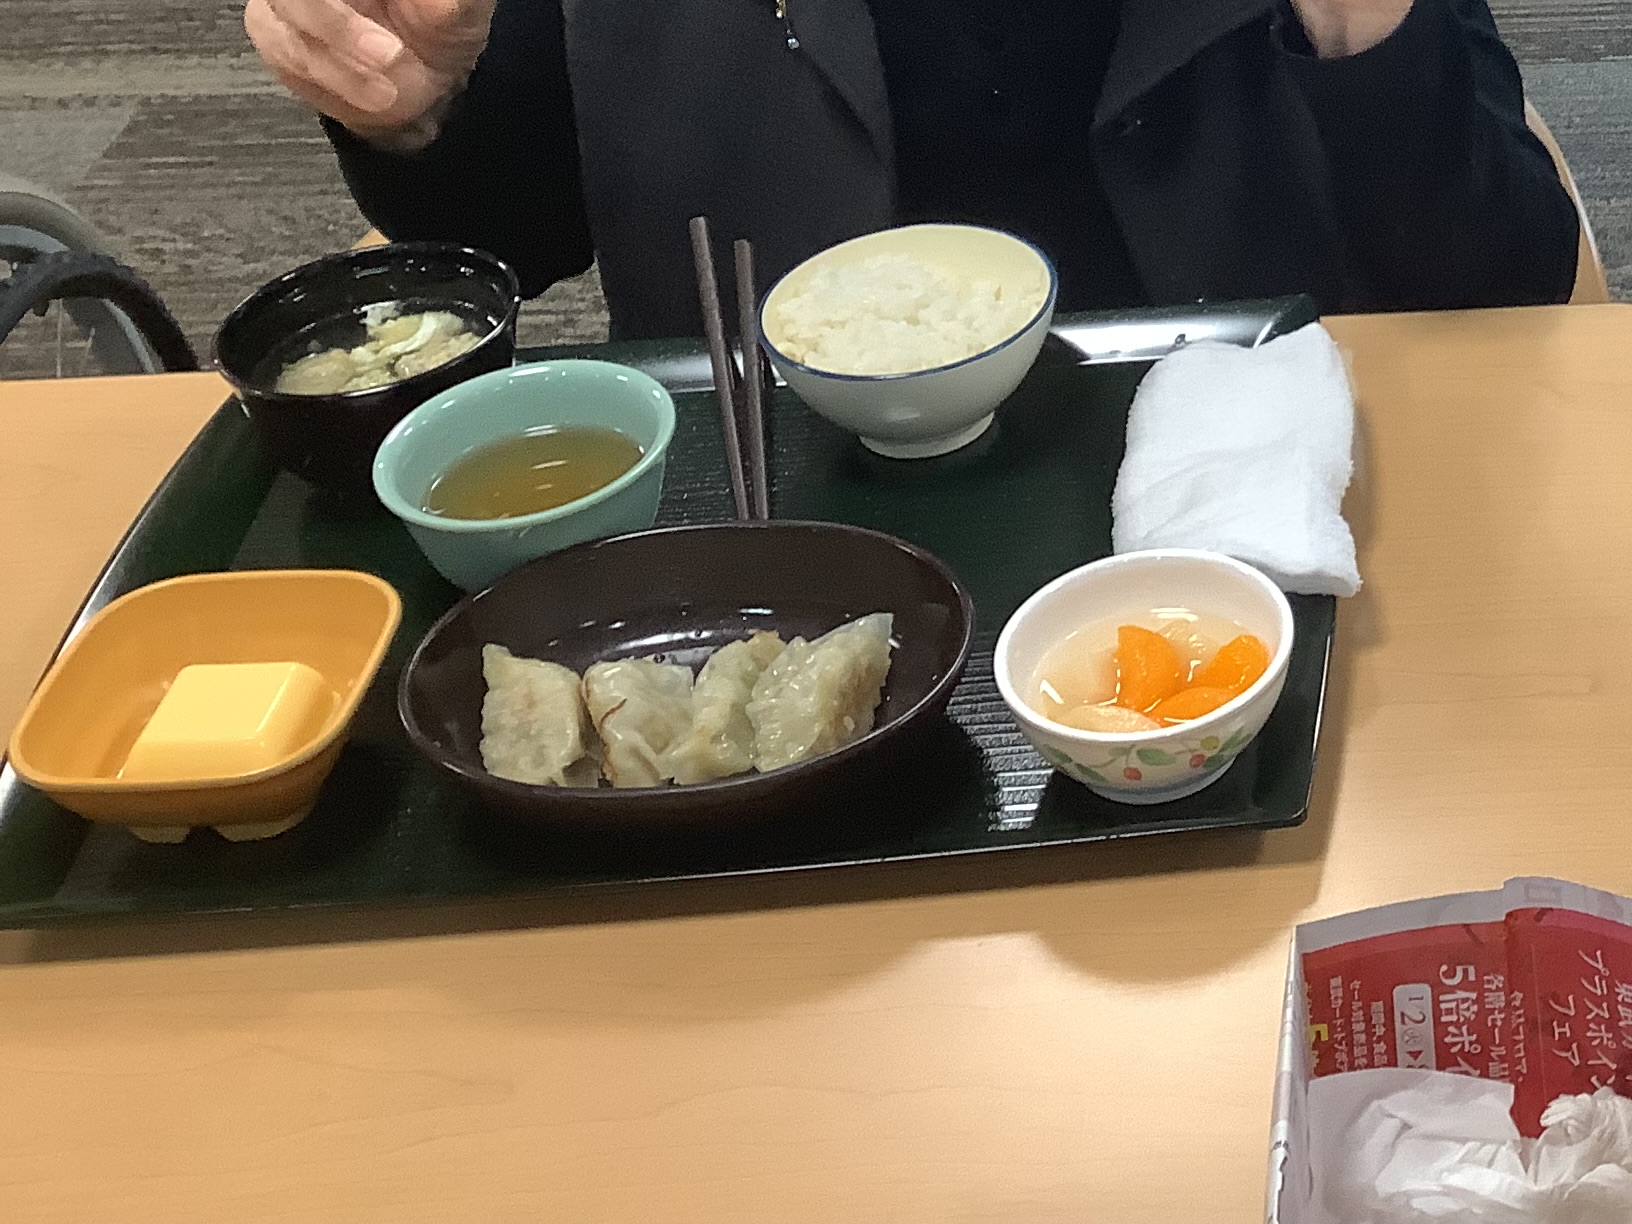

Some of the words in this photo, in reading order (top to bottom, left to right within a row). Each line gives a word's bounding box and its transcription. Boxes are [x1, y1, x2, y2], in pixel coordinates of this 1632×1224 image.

[1484, 973, 1511, 1083] 各階セール品
[1548, 994, 1580, 1066] フェア
